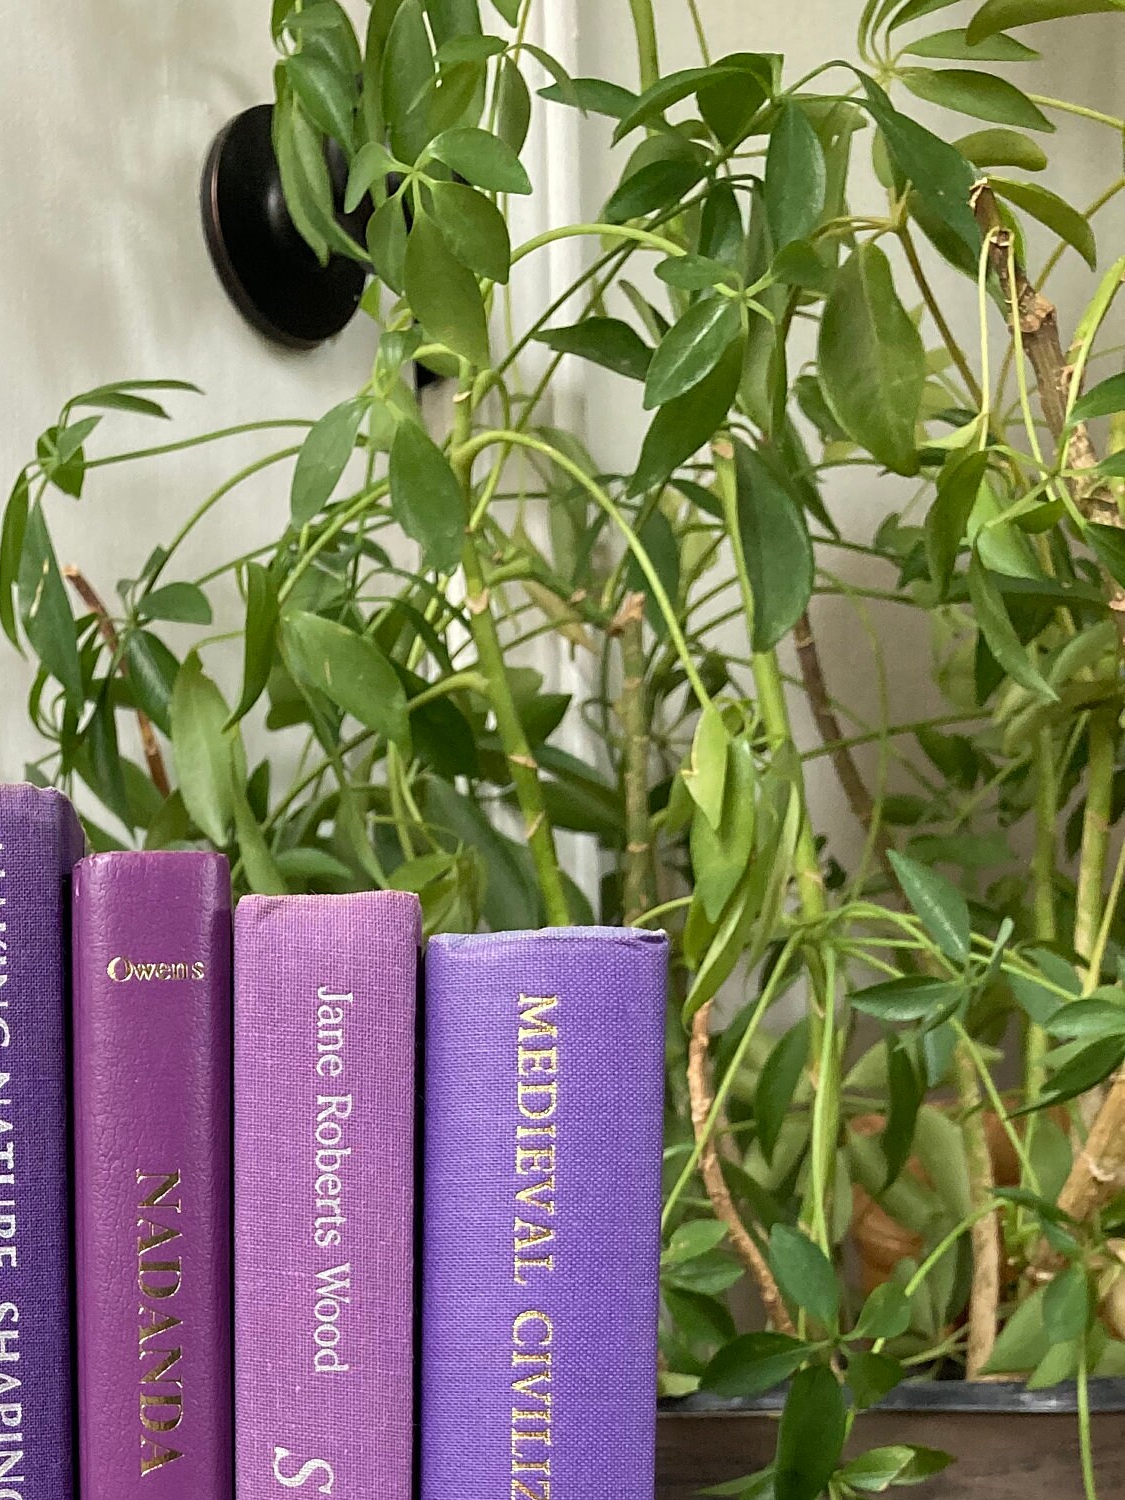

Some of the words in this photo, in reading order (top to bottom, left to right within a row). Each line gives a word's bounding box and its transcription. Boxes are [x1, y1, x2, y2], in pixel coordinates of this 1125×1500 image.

[106, 955, 205, 983] Owens
[315, 984, 354, 1079] Jane
[313, 1093, 353, 1248] Roberts
[512, 992, 559, 1286] MEDIEVAL
[136, 1167, 185, 1478] NADANDA
[313, 1261, 352, 1374] Wood
